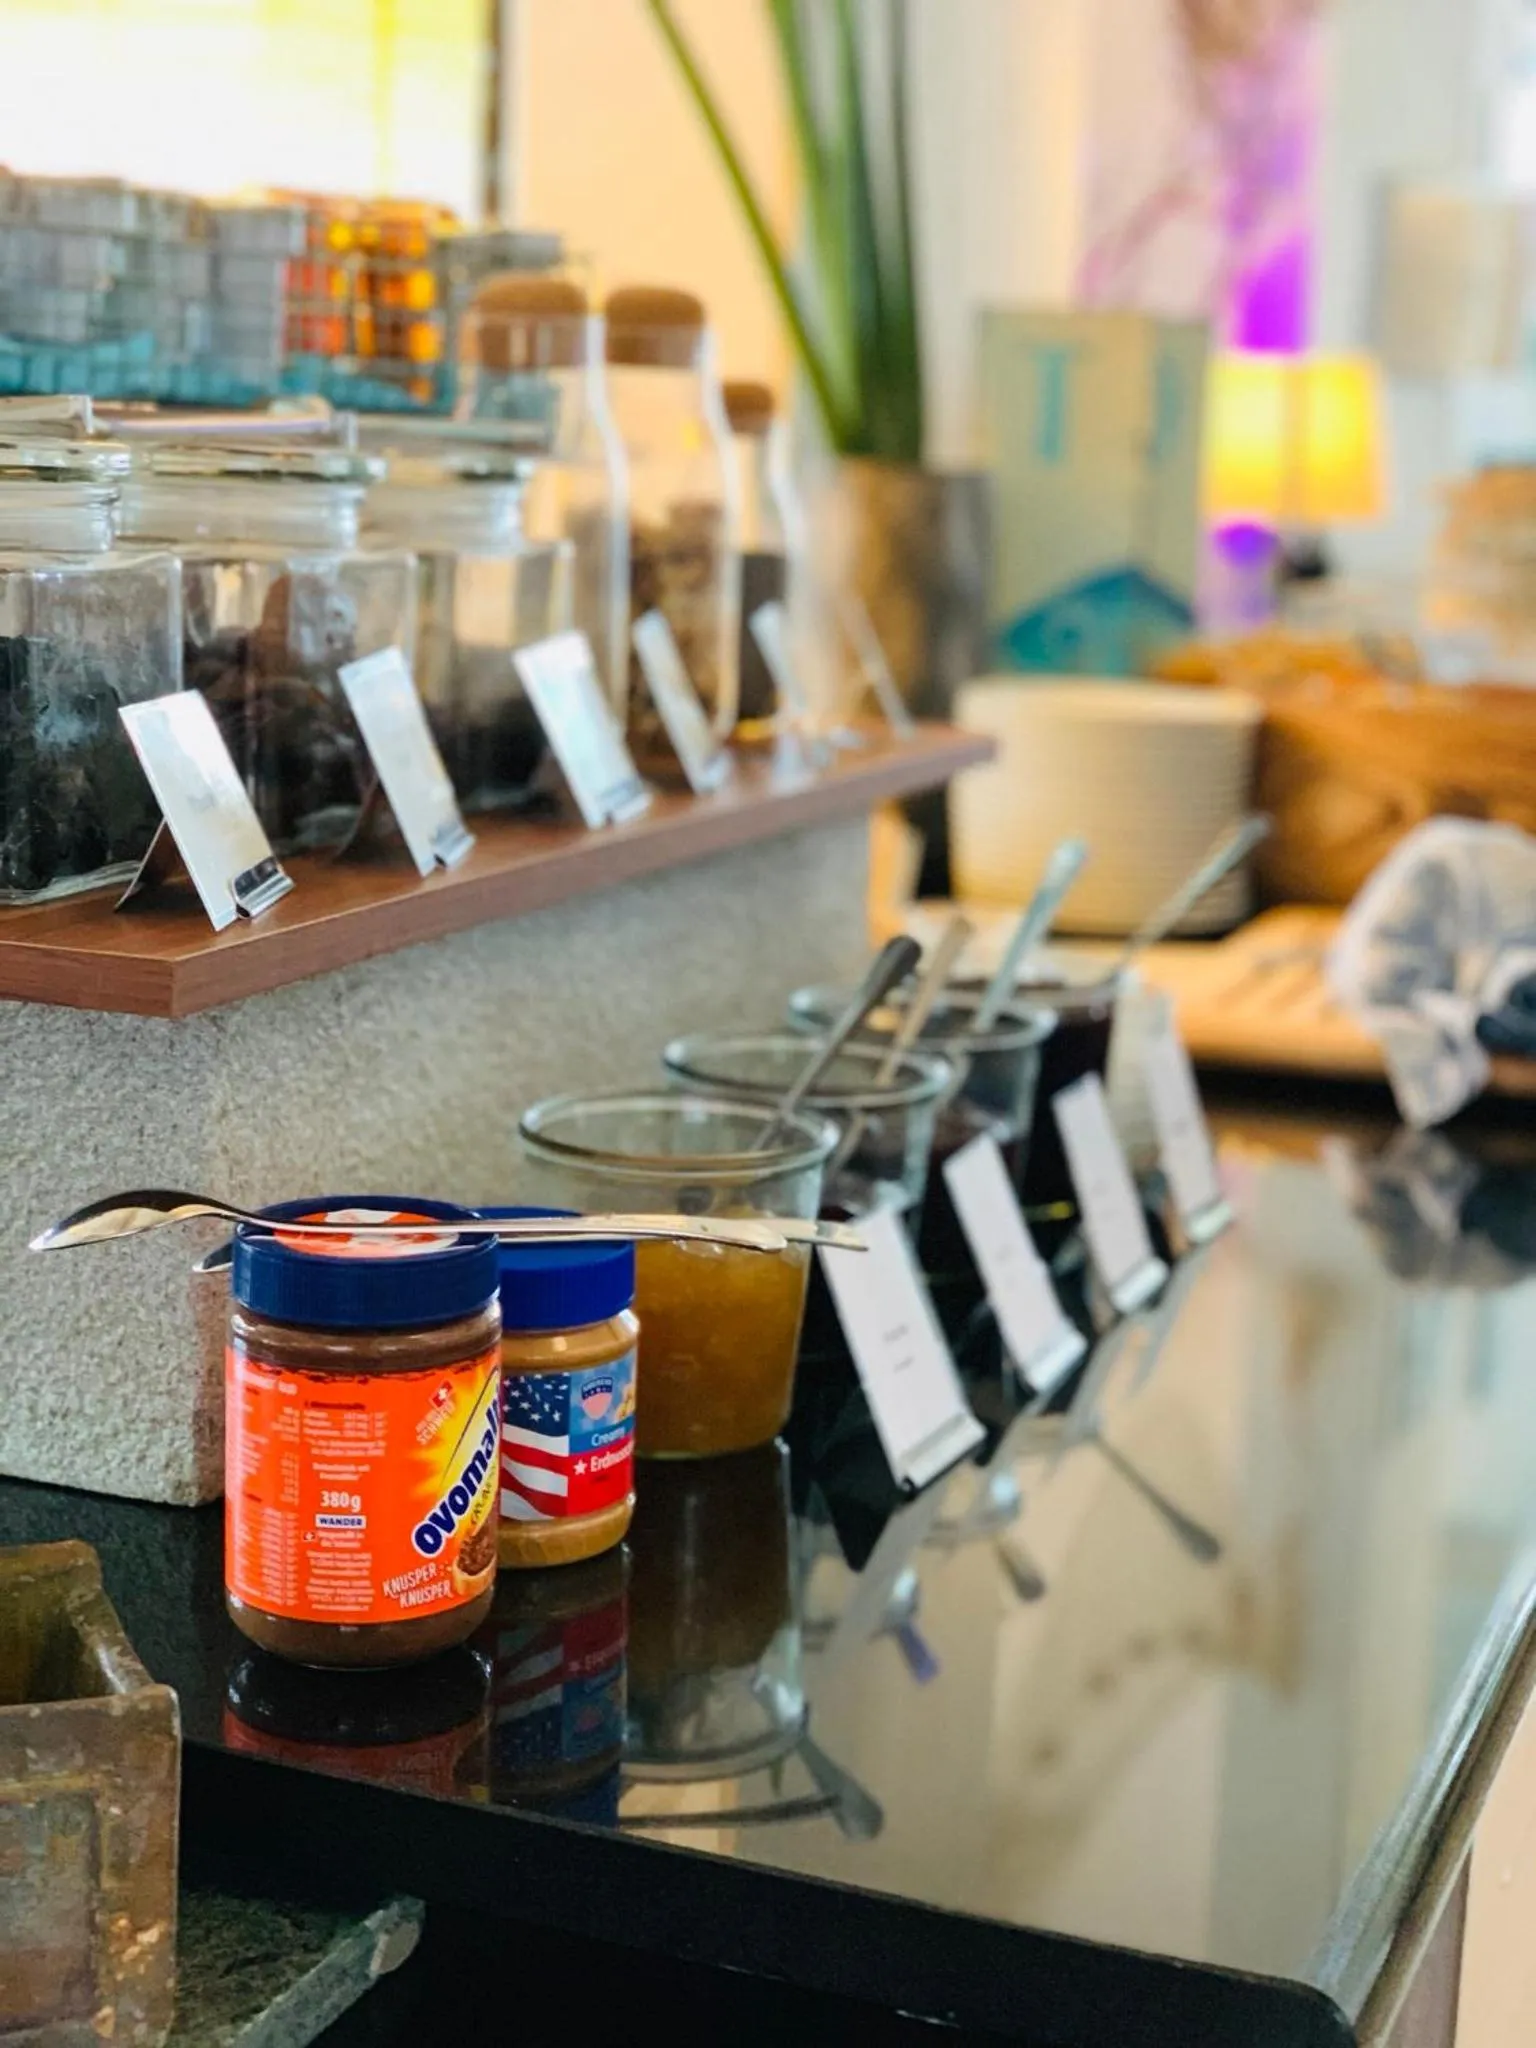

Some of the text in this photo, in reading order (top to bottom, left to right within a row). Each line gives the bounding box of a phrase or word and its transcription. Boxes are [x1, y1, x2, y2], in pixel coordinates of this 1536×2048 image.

[319, 1518, 363, 1526] WANDER
[382, 1562, 437, 1599] KNUSPER
[400, 1580, 454, 1608] KNUSPER
